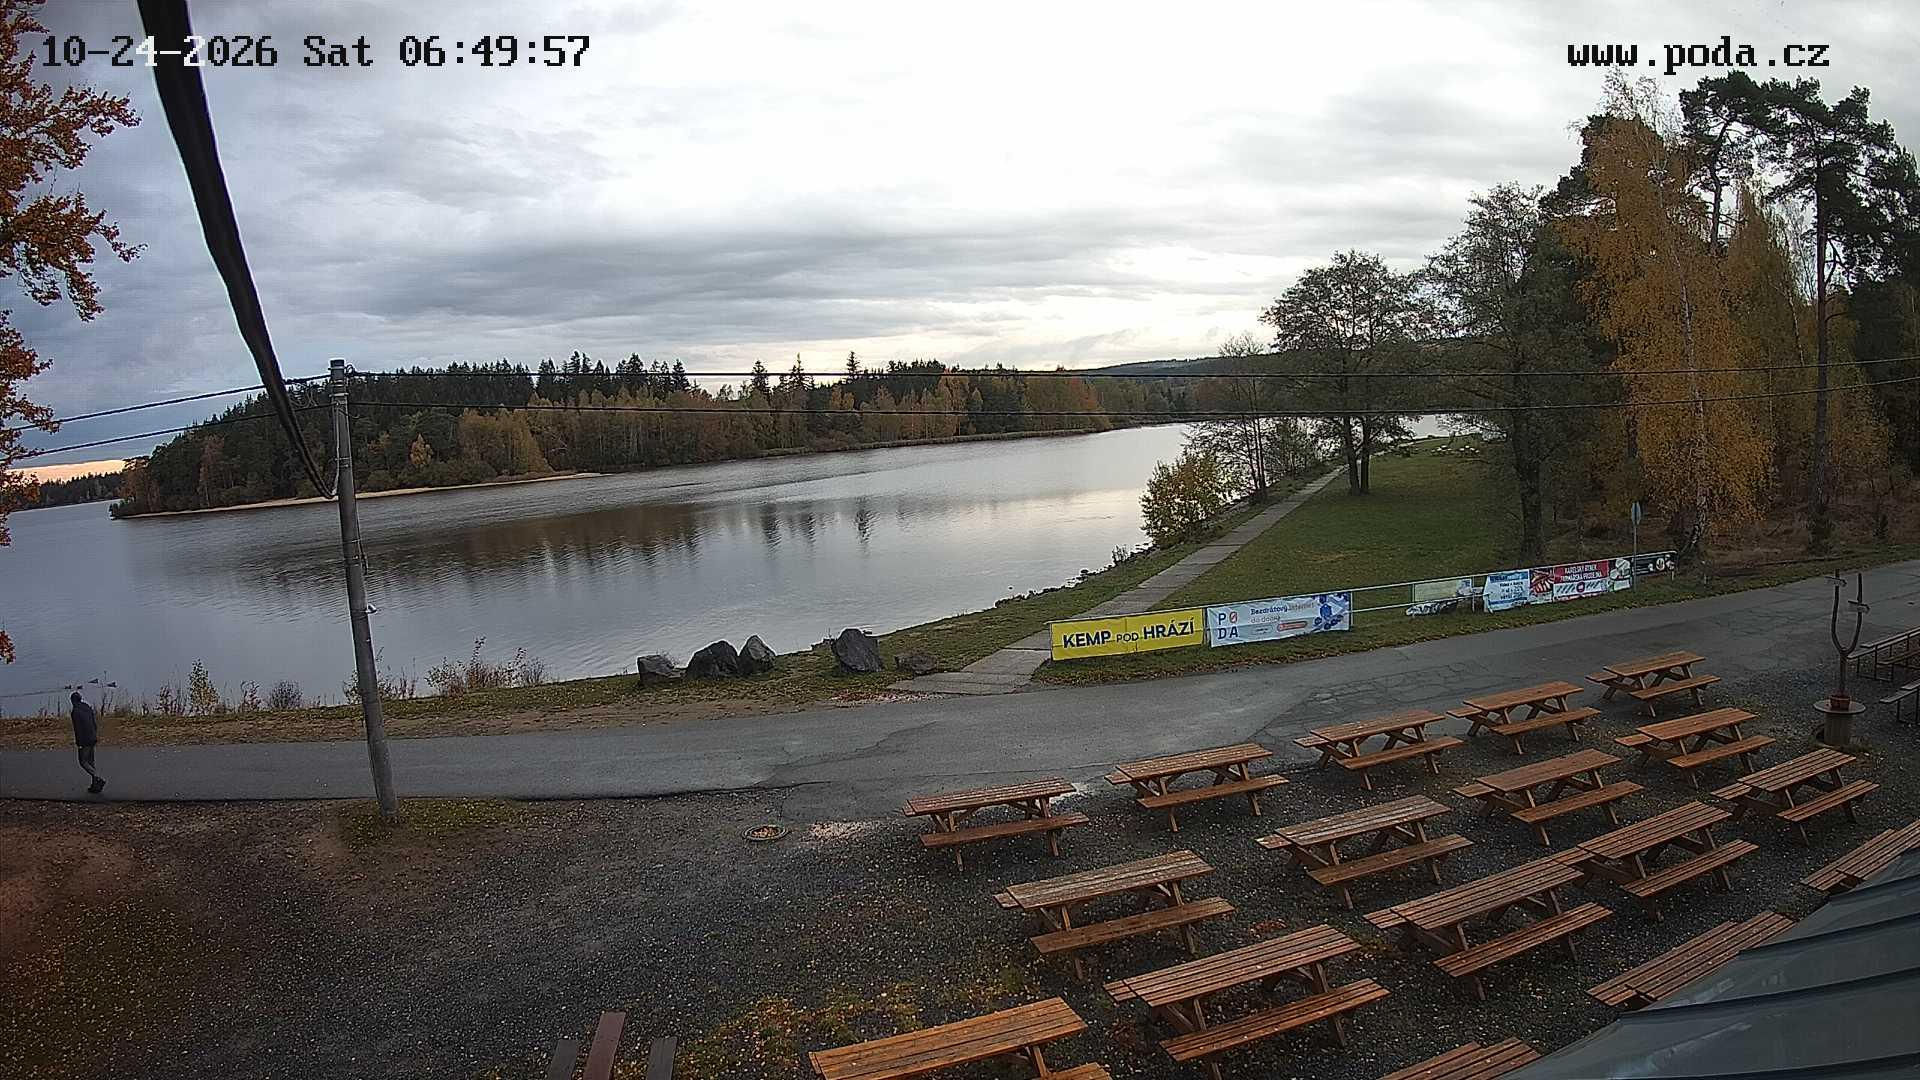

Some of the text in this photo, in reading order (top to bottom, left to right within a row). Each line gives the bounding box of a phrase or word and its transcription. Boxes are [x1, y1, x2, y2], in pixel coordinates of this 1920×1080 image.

[1063, 617, 1195, 648] KEMP POD HRÁZÍ
